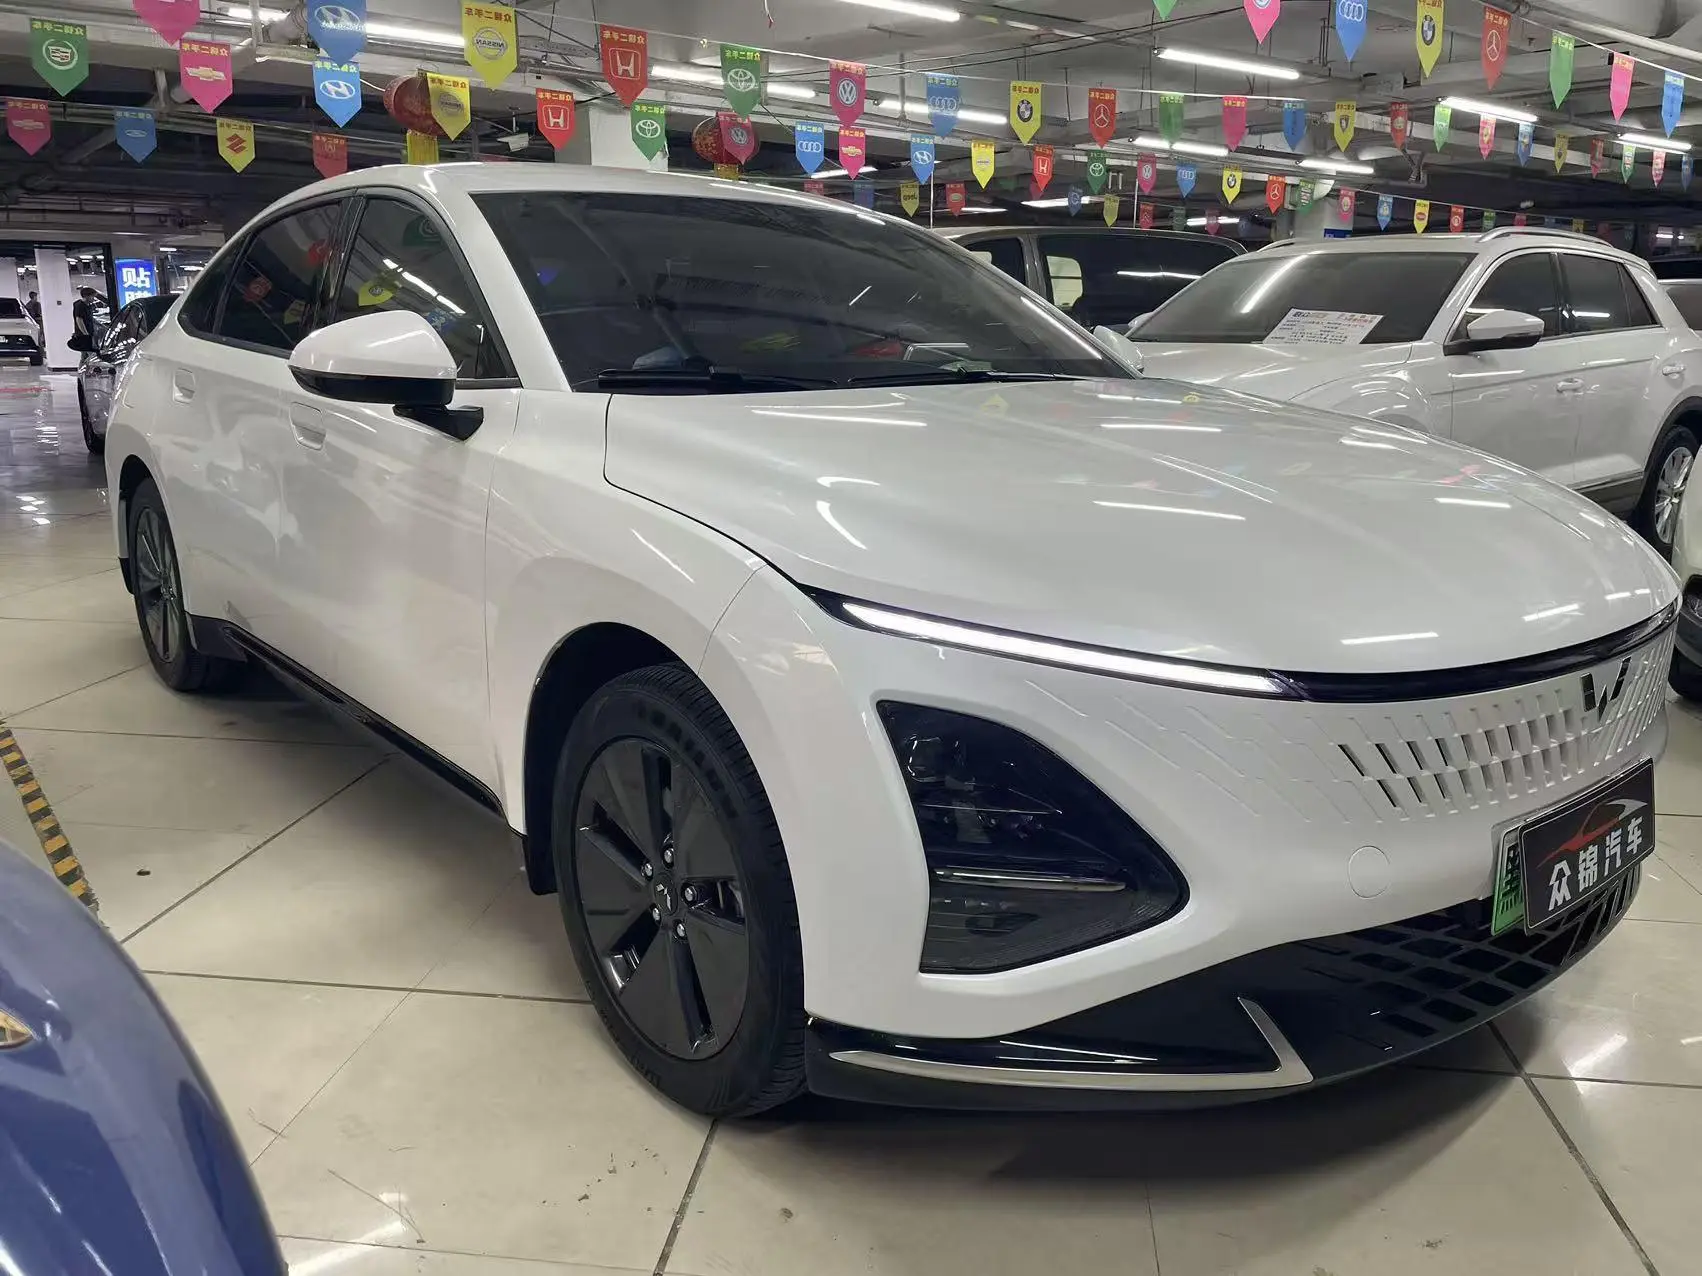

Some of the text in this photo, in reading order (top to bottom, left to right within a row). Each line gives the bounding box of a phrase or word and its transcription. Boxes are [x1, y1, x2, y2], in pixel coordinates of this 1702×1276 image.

[122, 266, 152, 288] 贴
[1548, 816, 1644, 912] 众锦汽车
